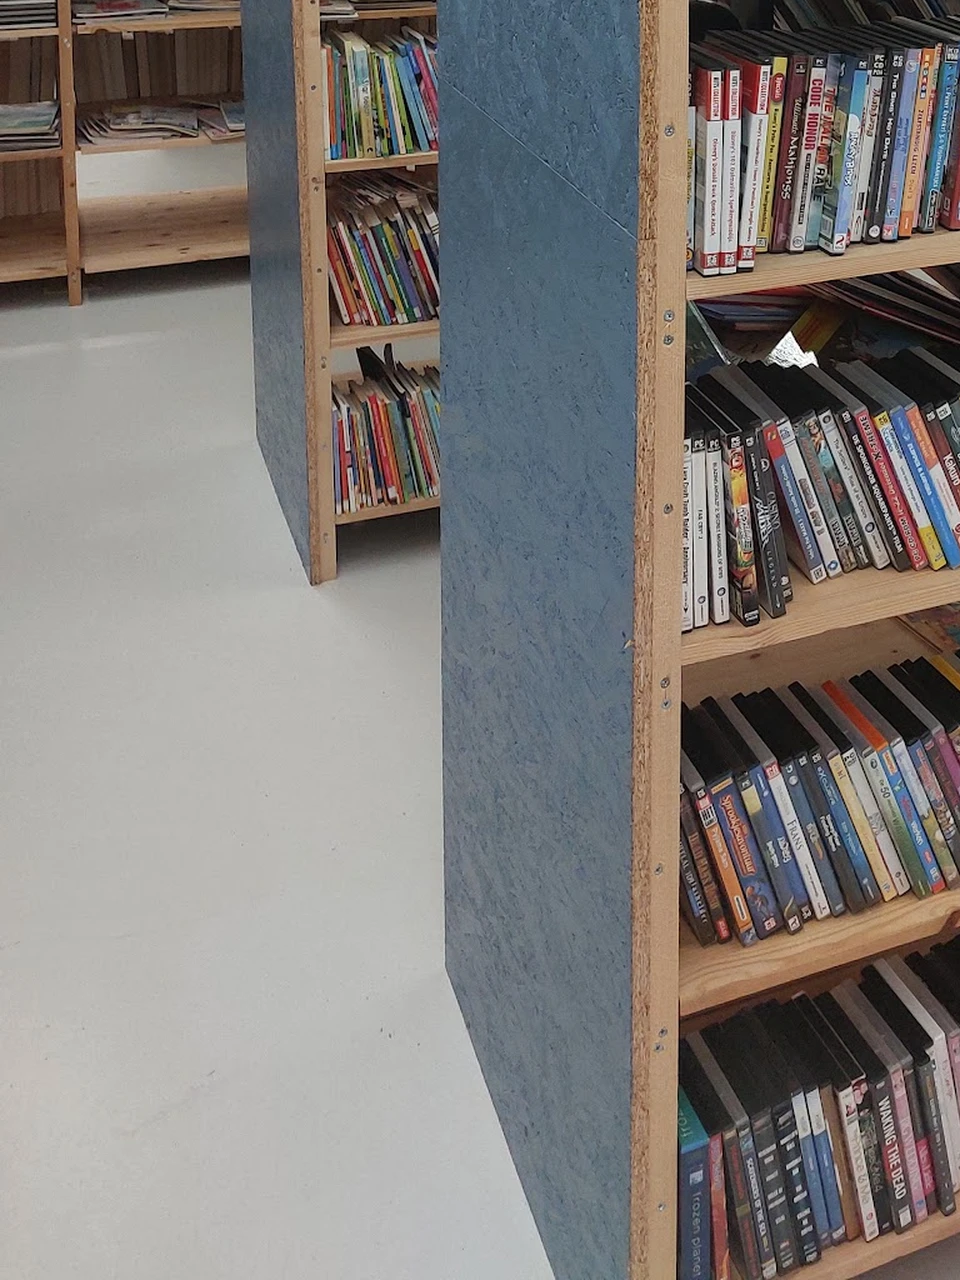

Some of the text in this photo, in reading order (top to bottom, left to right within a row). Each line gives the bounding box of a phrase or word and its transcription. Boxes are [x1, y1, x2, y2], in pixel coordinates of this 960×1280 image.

[809, 78, 823, 108] CODE
[804, 113, 820, 151] HONOR
[694, 438, 704, 448] PC
[943, 451, 960, 486] Kakuro
[766, 491, 782, 531] CASINO
[851, 434, 859, 444] DE
[855, 444, 874, 485] SPONGEBOB
[892, 534, 903, 554] FILM
[880, 786, 891, 799] 50
[786, 819, 806, 851] FRANS
[878, 1095, 907, 1200] WAKING THE DEAD
